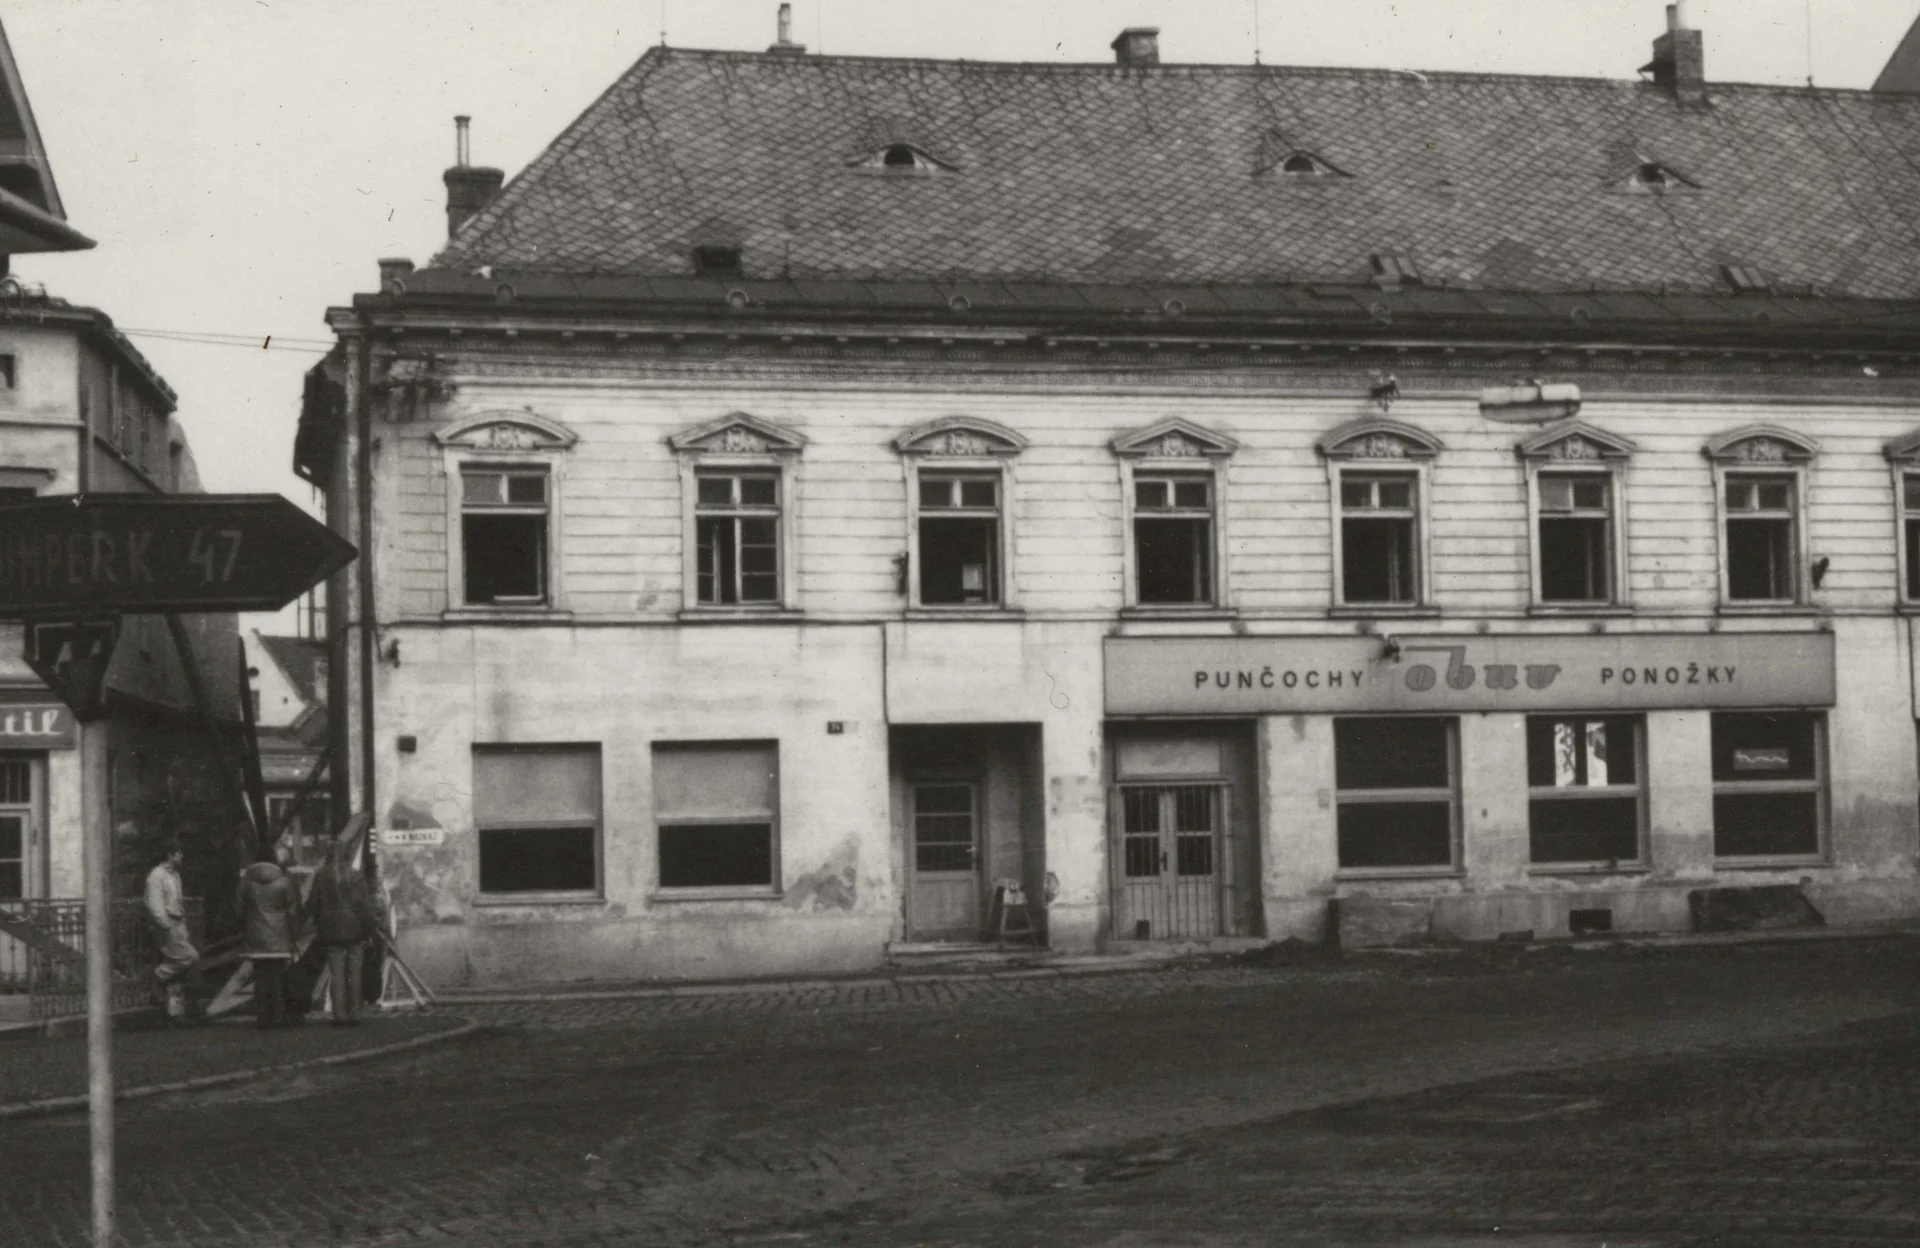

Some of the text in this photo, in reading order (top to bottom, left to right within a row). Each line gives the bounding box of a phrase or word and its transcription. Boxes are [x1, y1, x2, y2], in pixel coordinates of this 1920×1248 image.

[187, 528, 243, 583] 47
[1194, 645, 1736, 692] PUNČOCHY obuv PONOŽKY
